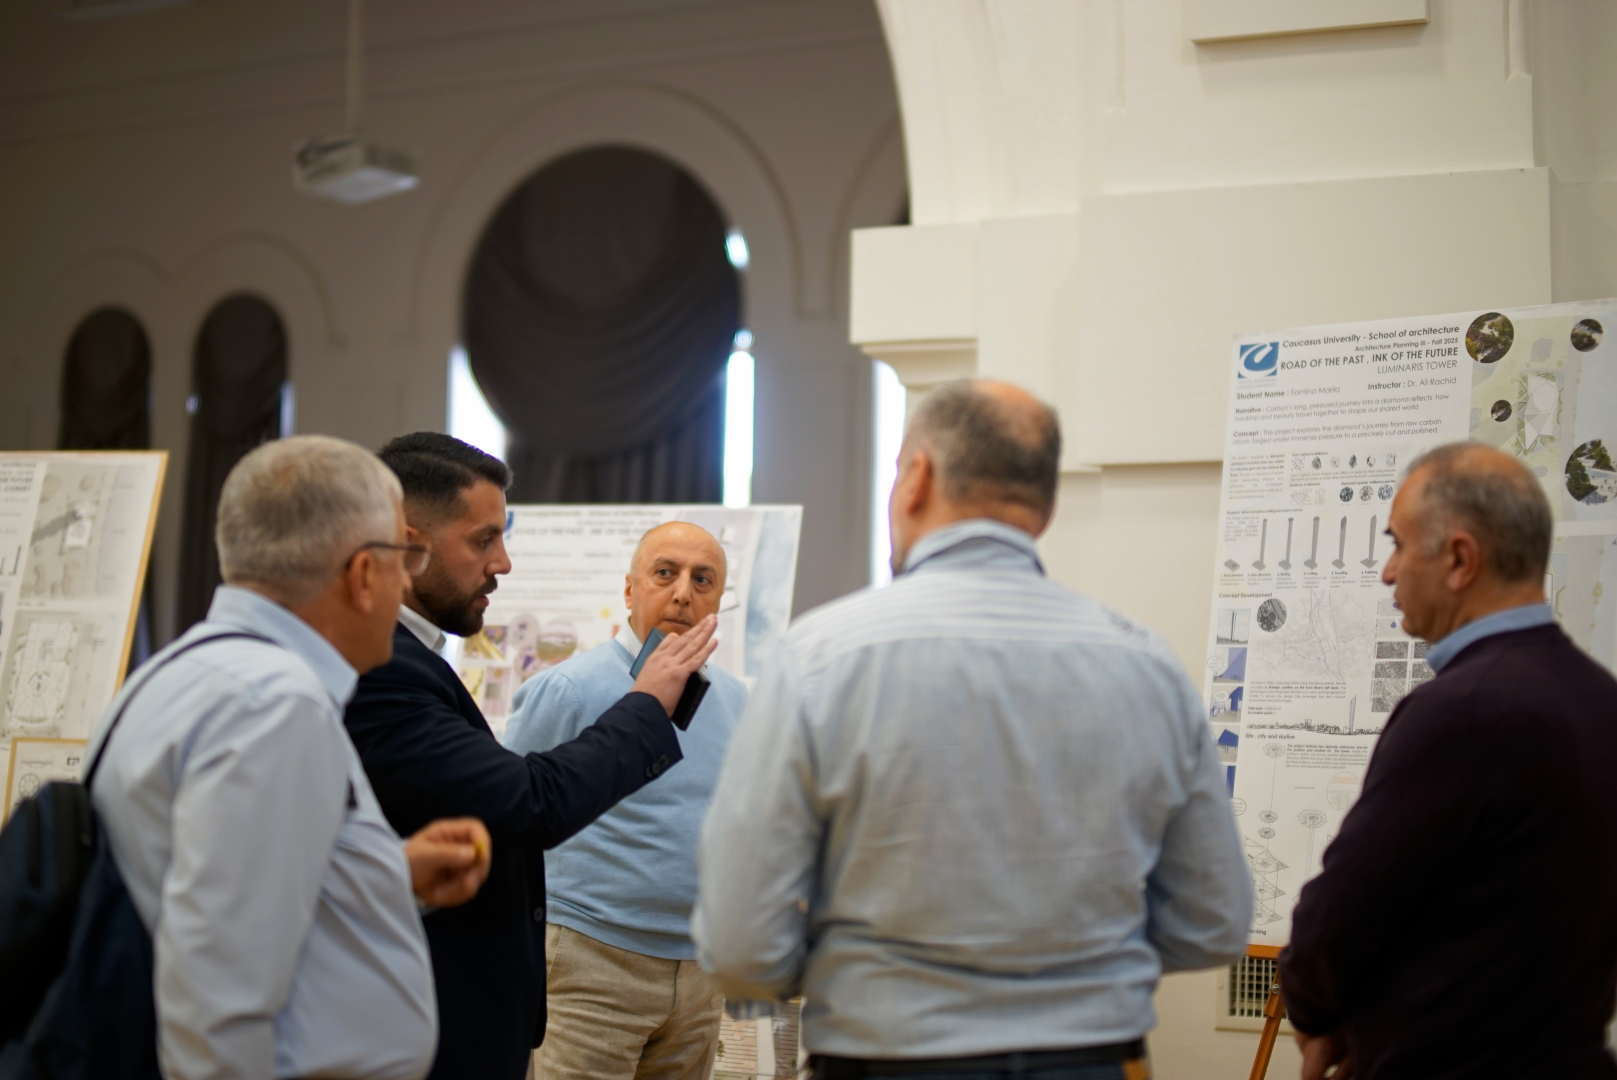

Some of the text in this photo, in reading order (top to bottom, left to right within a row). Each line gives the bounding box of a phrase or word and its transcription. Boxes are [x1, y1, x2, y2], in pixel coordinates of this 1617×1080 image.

[1283, 338, 1322, 348] Caucasus
[1324, 334, 1361, 345] University
[1368, 331, 1396, 340] School
[1399, 329, 1408, 338] of
[1409, 326, 1460, 336] architecture
[1355, 343, 1391, 352] Architecture
[1280, 360, 1307, 370] ROAD
[1310, 358, 1322, 368] OF
[1325, 357, 1340, 366] THE
[1342, 355, 1364, 366] PAST
[1372, 353, 1388, 362] INK
[1391, 352, 1404, 360] OF
[1406, 350, 1422, 360] THE
[1426, 347, 1458, 358] FUTURE
[1378, 360, 1458, 374] LUMINARIS TOWER
[1368, 382, 1401, 390] Instructor
[1419, 378, 1428, 386] Ali
[1430, 377, 1456, 385] Rachid
[1236, 392, 1262, 400] Student
[1310, 402, 1338, 410] pressured
[1338, 400, 1361, 408] journey
[1235, 414, 1260, 422] hardship
[1274, 412, 1294, 420] beauty
[1314, 408, 1340, 418] together
[1234, 430, 1258, 438] Concept
[1274, 428, 1296, 437] project
[1296, 426, 1320, 434] explores
[1318, 434, 1344, 442] pressure
[1358, 430, 1384, 440] precisely
[1411, 428, 1438, 436] polished
